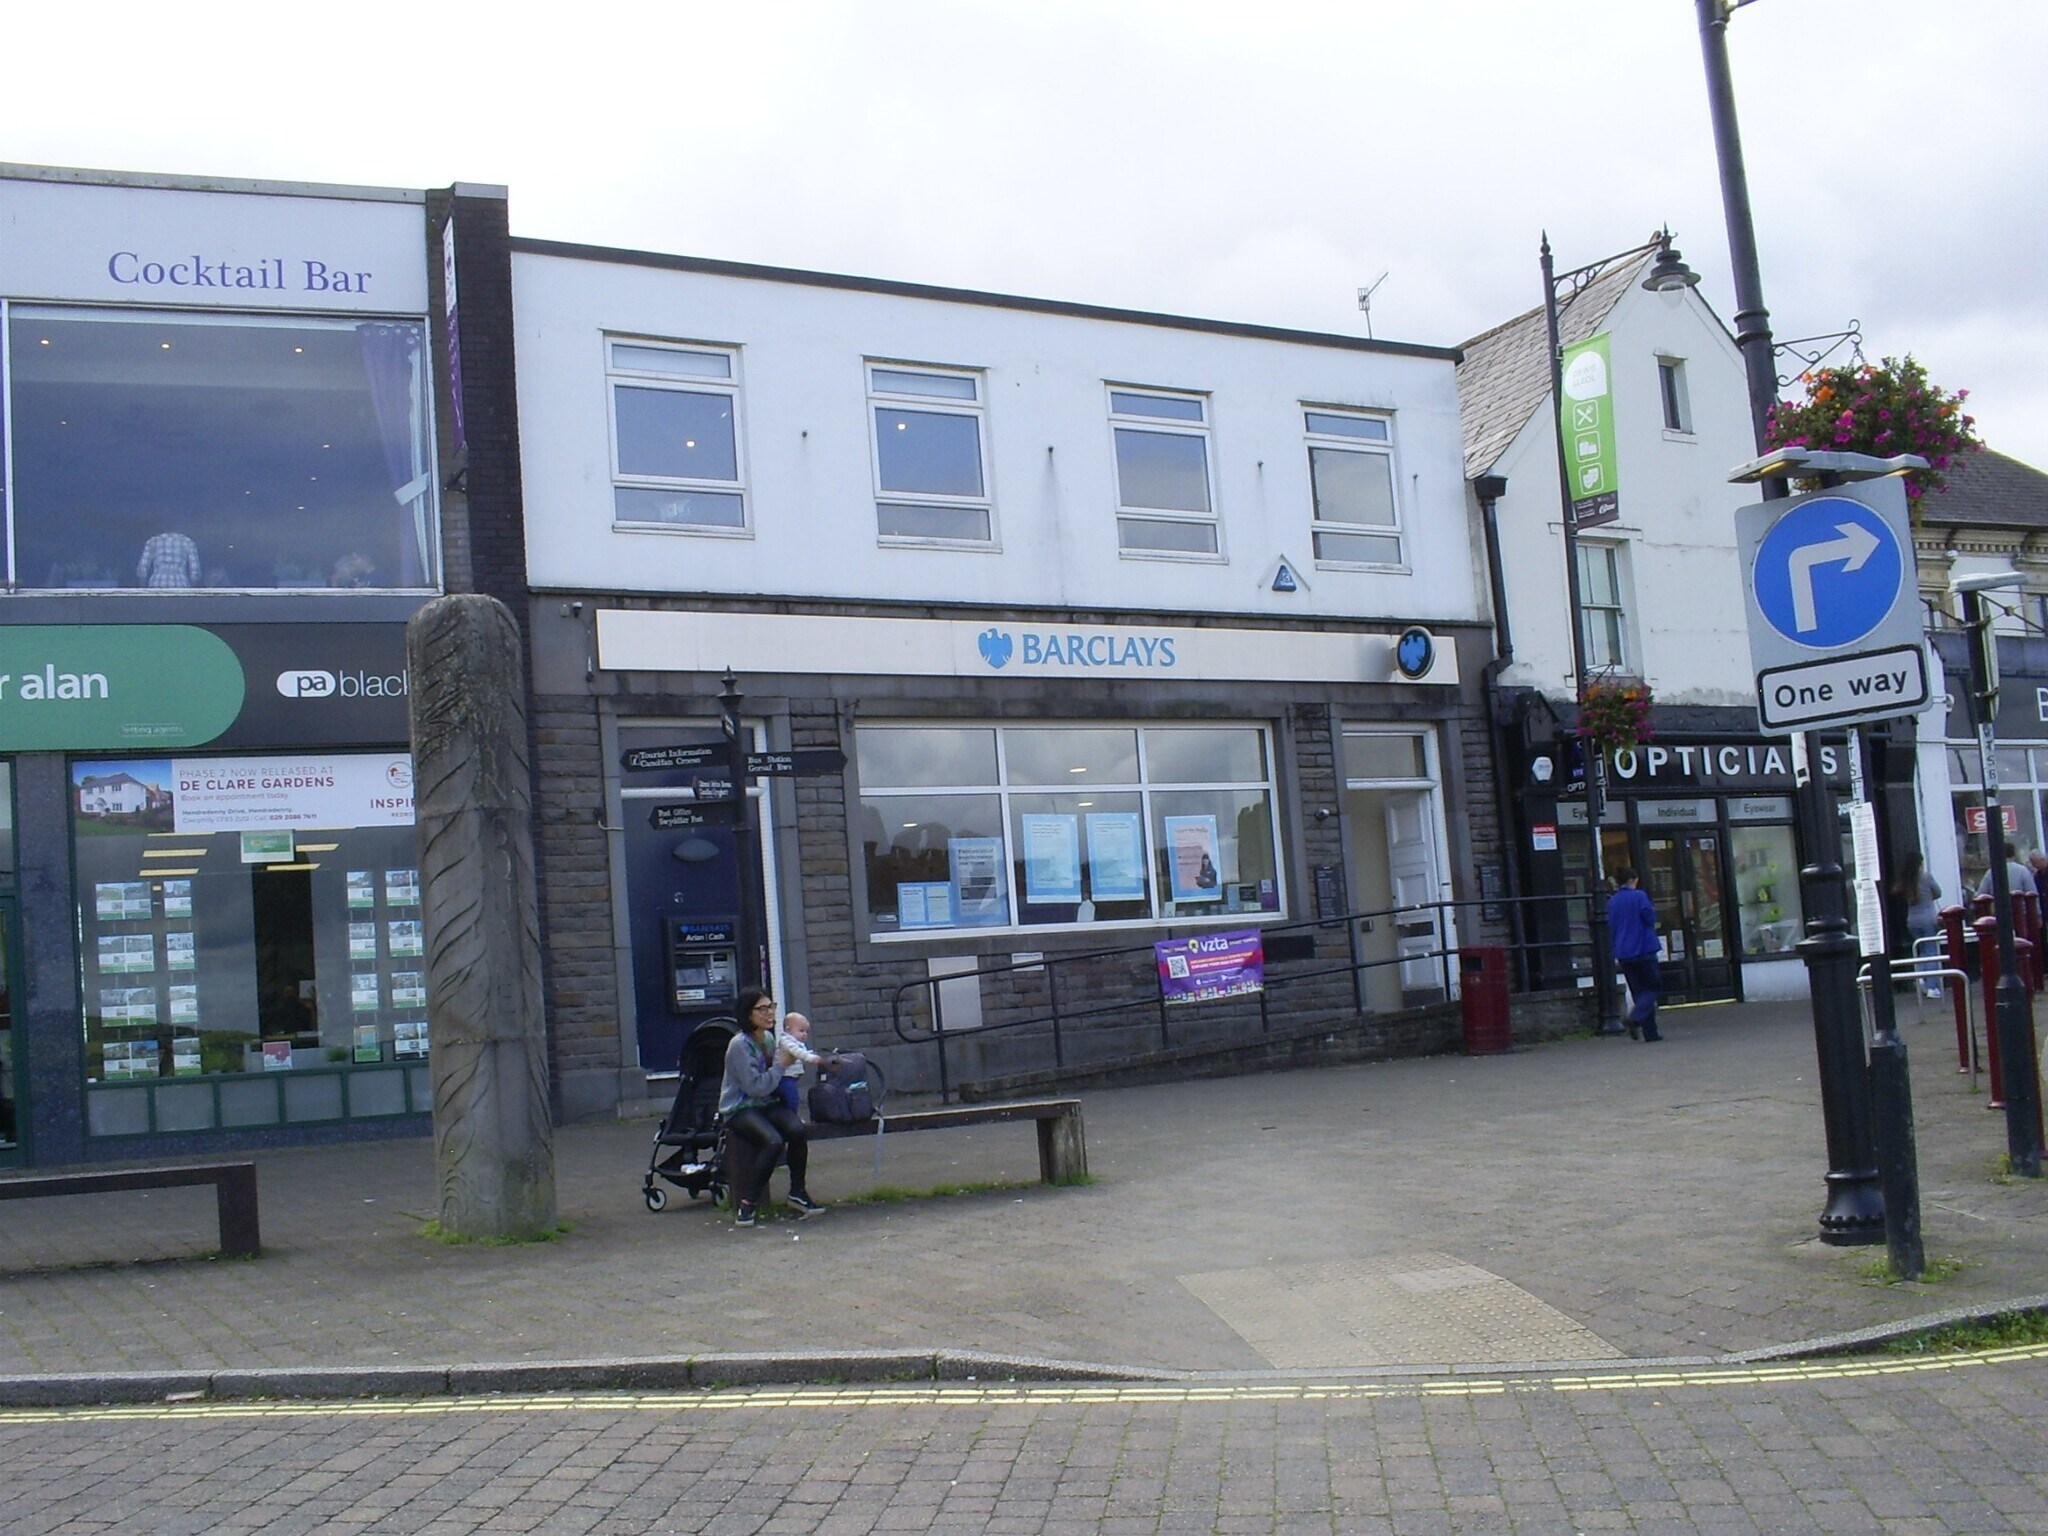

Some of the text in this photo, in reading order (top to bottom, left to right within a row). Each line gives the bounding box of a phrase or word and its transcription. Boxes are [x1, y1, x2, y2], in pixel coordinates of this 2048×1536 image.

[108, 252, 372, 293] Cocktail Bar
[1022, 634, 1176, 667] BARCLAYS
[20, 664, 109, 700] alan
[1775, 670, 1907, 708] One way
[639, 748, 712, 760] Tourist Information
[766, 755, 792, 763] Station
[1614, 746, 1838, 779] OPTICIAS
[179, 766, 334, 778] PHASE 2 NOW RELEASED AT
[180, 777, 335, 791] DE CLARE GARDENS
[215, 793, 265, 802] appointment
[266, 792, 289, 801] today
[1657, 806, 1697, 817] Individual
[1744, 803, 1777, 814] Eyewear
[1200, 937, 1229, 953] vzta
